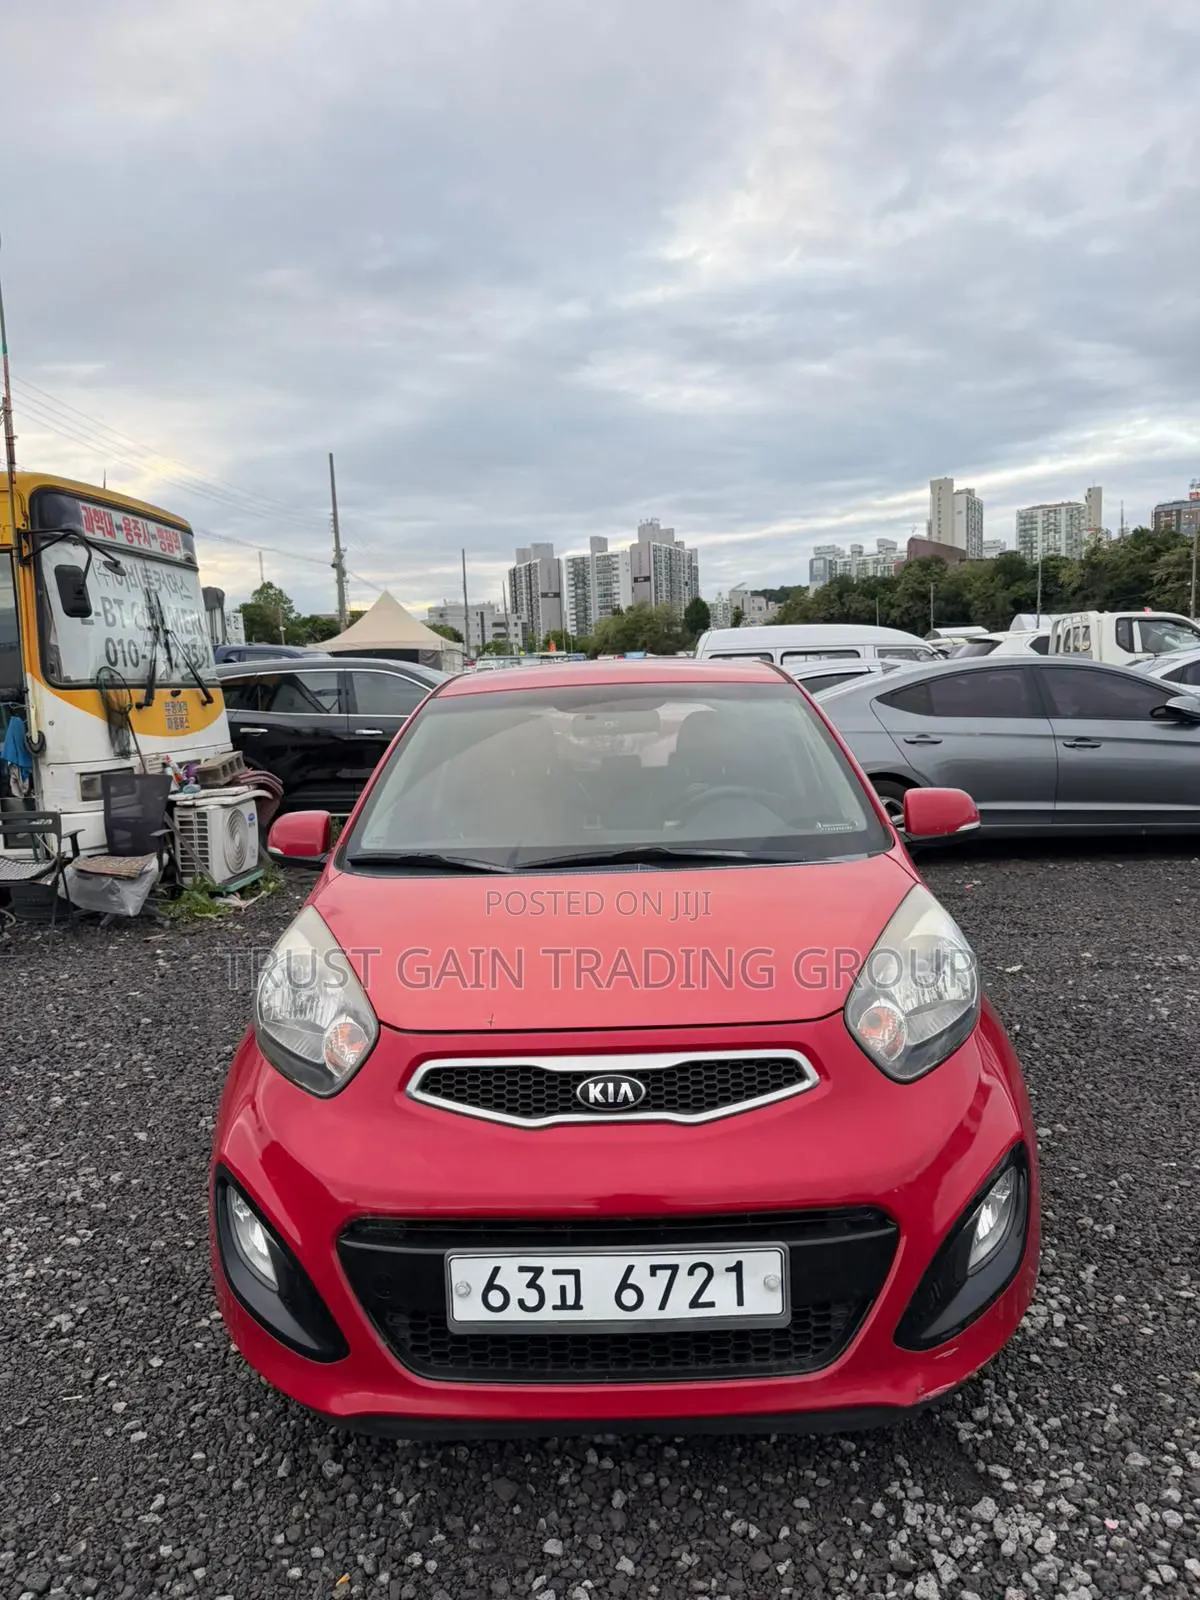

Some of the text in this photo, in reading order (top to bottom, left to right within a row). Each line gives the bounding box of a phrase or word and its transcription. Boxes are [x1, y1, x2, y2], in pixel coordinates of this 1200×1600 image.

[587, 1082, 635, 1103] KIA
[480, 1260, 745, 1313] 63고 6721
